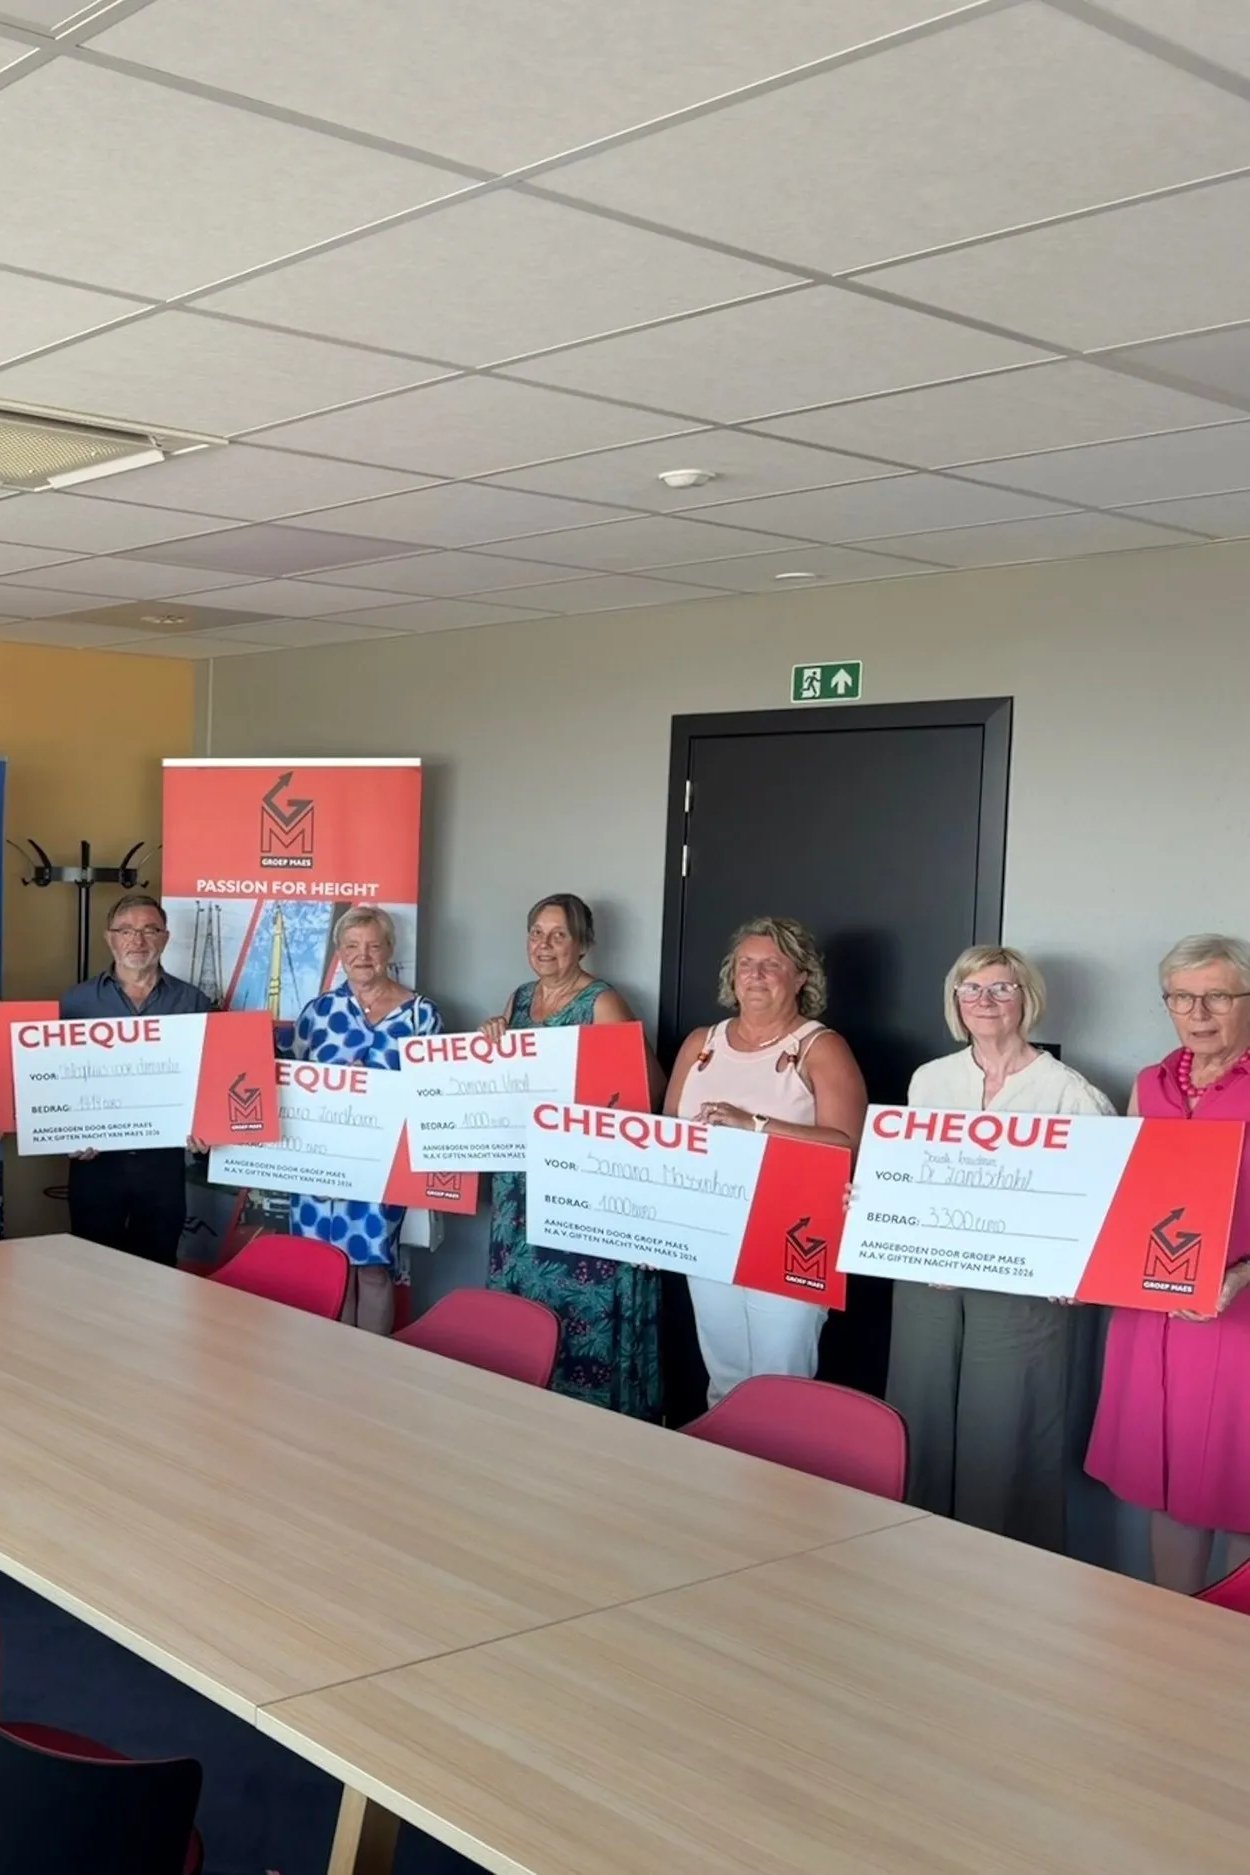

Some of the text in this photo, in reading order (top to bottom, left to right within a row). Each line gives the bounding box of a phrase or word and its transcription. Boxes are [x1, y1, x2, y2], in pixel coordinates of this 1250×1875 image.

[262, 858, 312, 867] GROEP MAES
[196, 880, 379, 896] PASSION FOR HEIGHT
[18, 1019, 160, 1048] CHEQUE
[404, 1032, 537, 1063] CHEQUE
[276, 1062, 368, 1094] EQUE
[535, 1105, 708, 1154] CHEQUE
[873, 1110, 1071, 1151] CHEQUE
[545, 1158, 577, 1171] VOOR:
[876, 1170, 913, 1182] VOOR:
[545, 1194, 590, 1209] BEDRAG:
[866, 1212, 920, 1225] BEDRAG:
[545, 1218, 688, 1251] AANGEBODEN DOOR GROEP MAES
[569, 1232, 599, 1243] GIFTEN
[602, 1238, 632, 1249] NACHT
[633, 1245, 651, 1253] VAN
[654, 1248, 677, 1259] MAES
[860, 1240, 1026, 1265] AANGEBODEN DOOR GROEP MAES
[886, 1253, 921, 1264] GIFTEN
[924, 1258, 958, 1268] NACHT
[960, 1262, 980, 1270] VAN
[982, 1265, 1010, 1274] MAES
[1012, 1268, 1034, 1277] 2026
[1143, 1281, 1192, 1292] GROEP MAES
